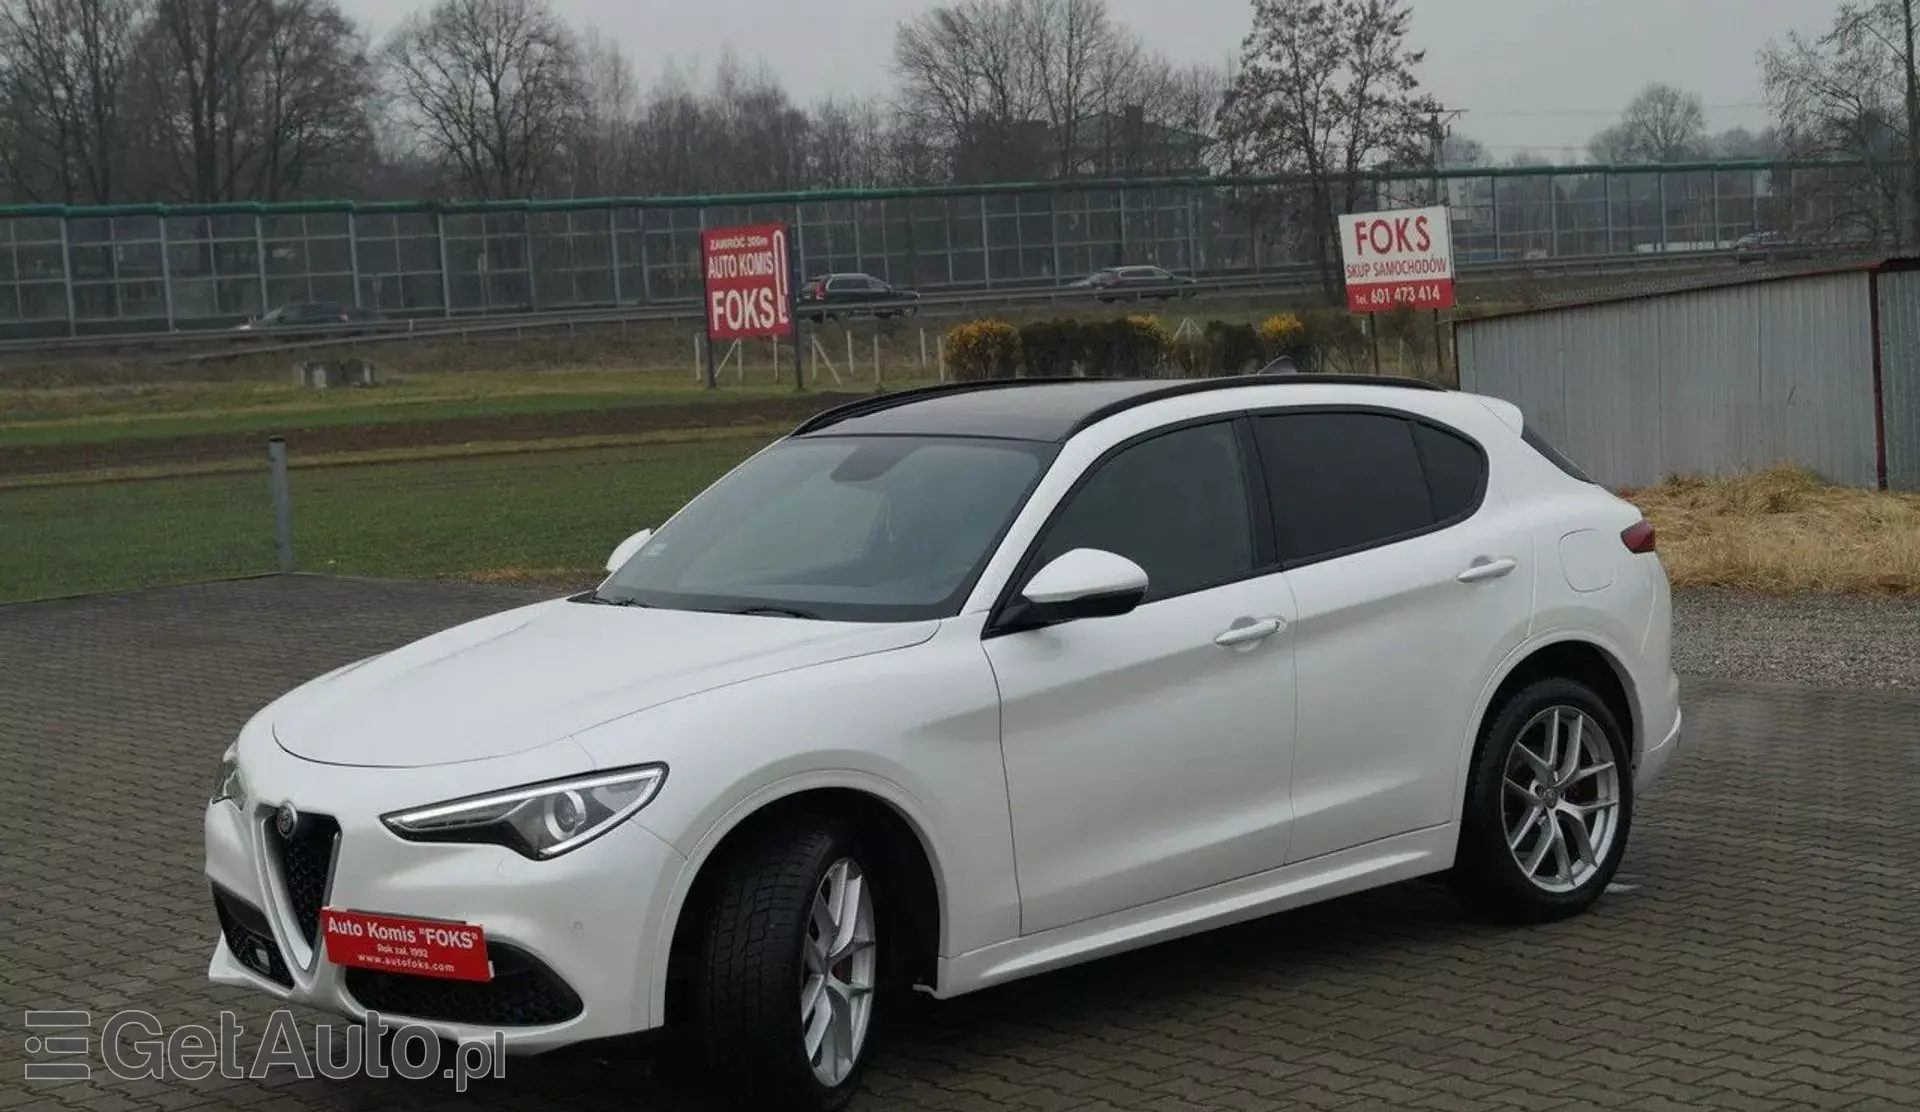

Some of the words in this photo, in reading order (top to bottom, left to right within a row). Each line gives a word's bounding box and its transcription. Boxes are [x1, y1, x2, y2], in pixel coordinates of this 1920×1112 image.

[1355, 216, 1430, 255] FOKS
[708, 254, 737, 278] AUTO
[739, 251, 773, 276] KOMIS
[1346, 264, 1370, 278] SKUP
[1373, 256, 1447, 277] SAMOCHODÓW
[1370, 288, 1391, 304] 601
[1393, 286, 1416, 303] 473
[1418, 284, 1441, 301] 414
[712, 287, 775, 331] FOKS
[328, 917, 363, 937] Auto
[367, 922, 416, 943] Komis
[419, 927, 478, 949] "FOKS"
[358, 954, 455, 972] www.autofoks.com
